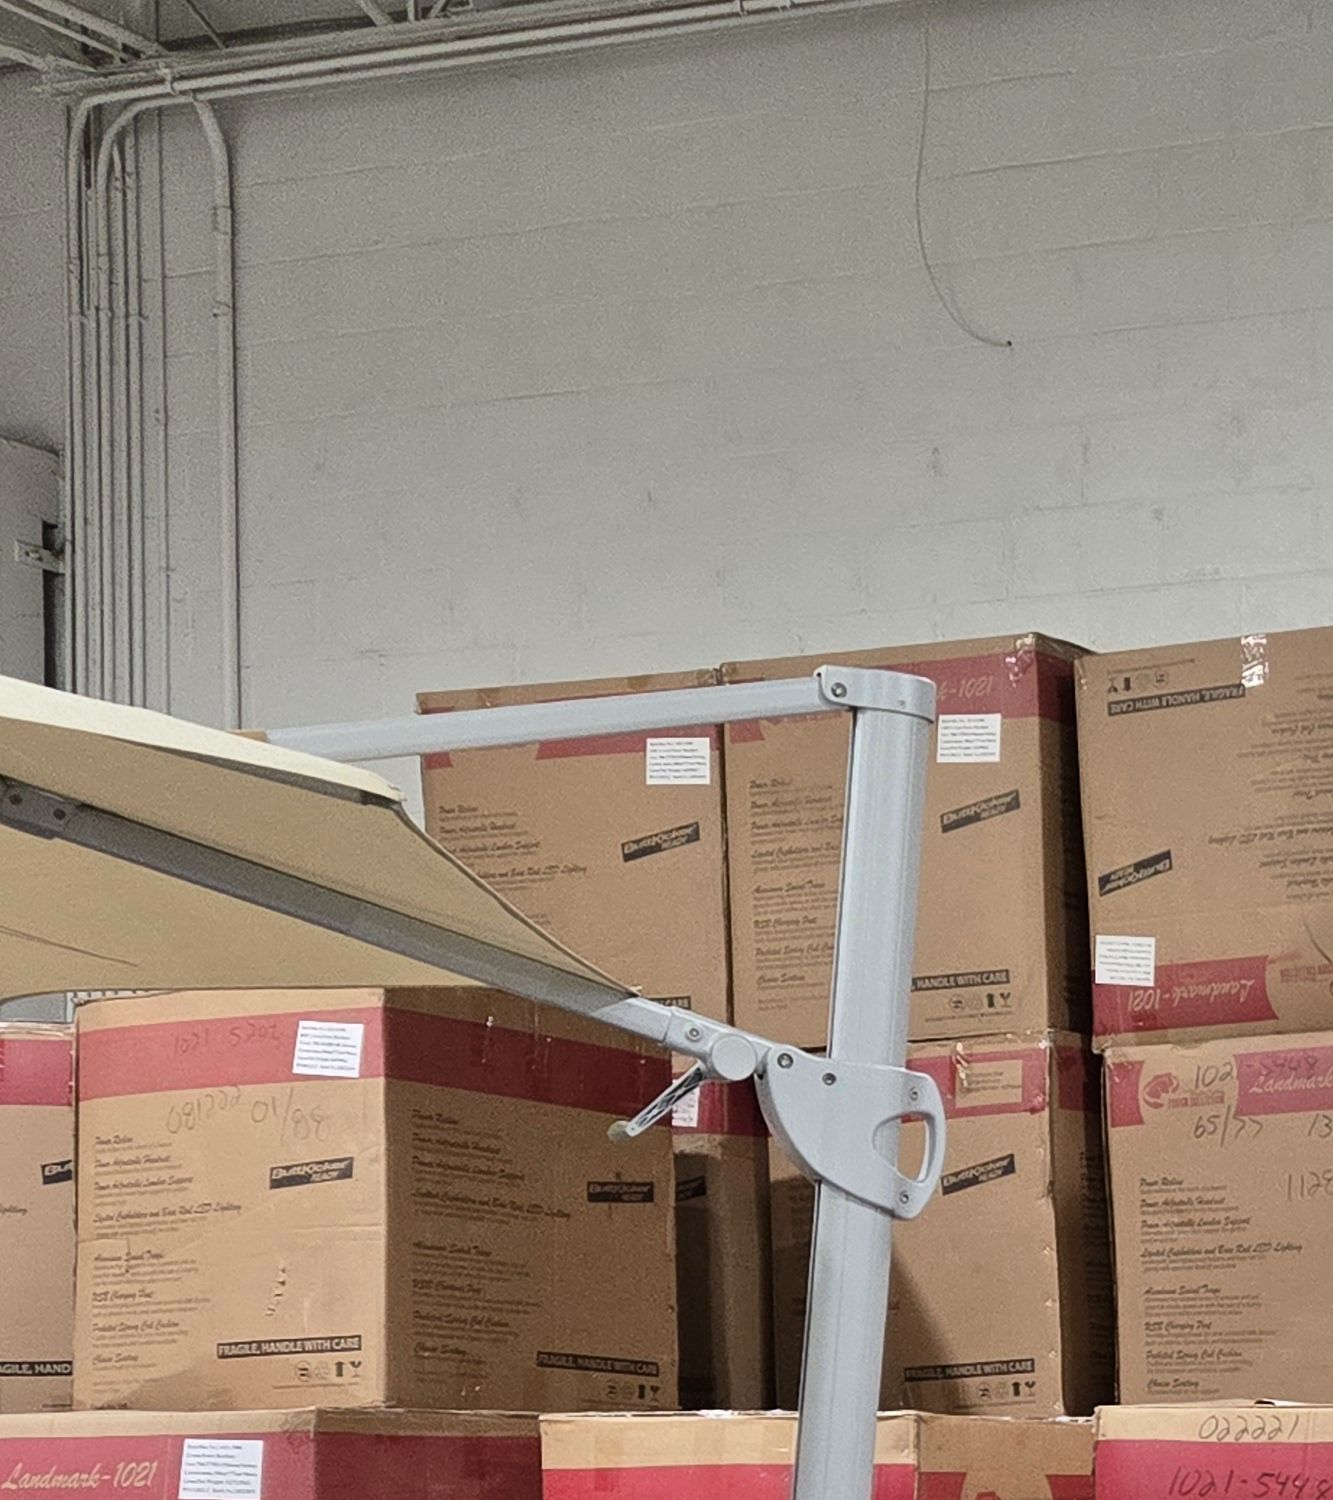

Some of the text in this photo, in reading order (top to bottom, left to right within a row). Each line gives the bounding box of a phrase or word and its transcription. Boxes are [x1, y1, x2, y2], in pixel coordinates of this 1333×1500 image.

[943, 791, 1019, 825] ButtKicker
[918, 970, 1009, 988] HANDLE WITH CARE
[1128, 979, 1255, 1013] Landmark-1021
[271, 1158, 353, 1179] ButtKicker
[311, 1169, 339, 1181] READY
[220, 1336, 359, 1357] FRAGILE, HANDLE WITH CARE
[944, 1360, 1032, 1377] HANDLE WITH CARE
[1199, 1414, 1300, 1443] 022221
[1, 1461, 159, 1491] Landmark-1021
